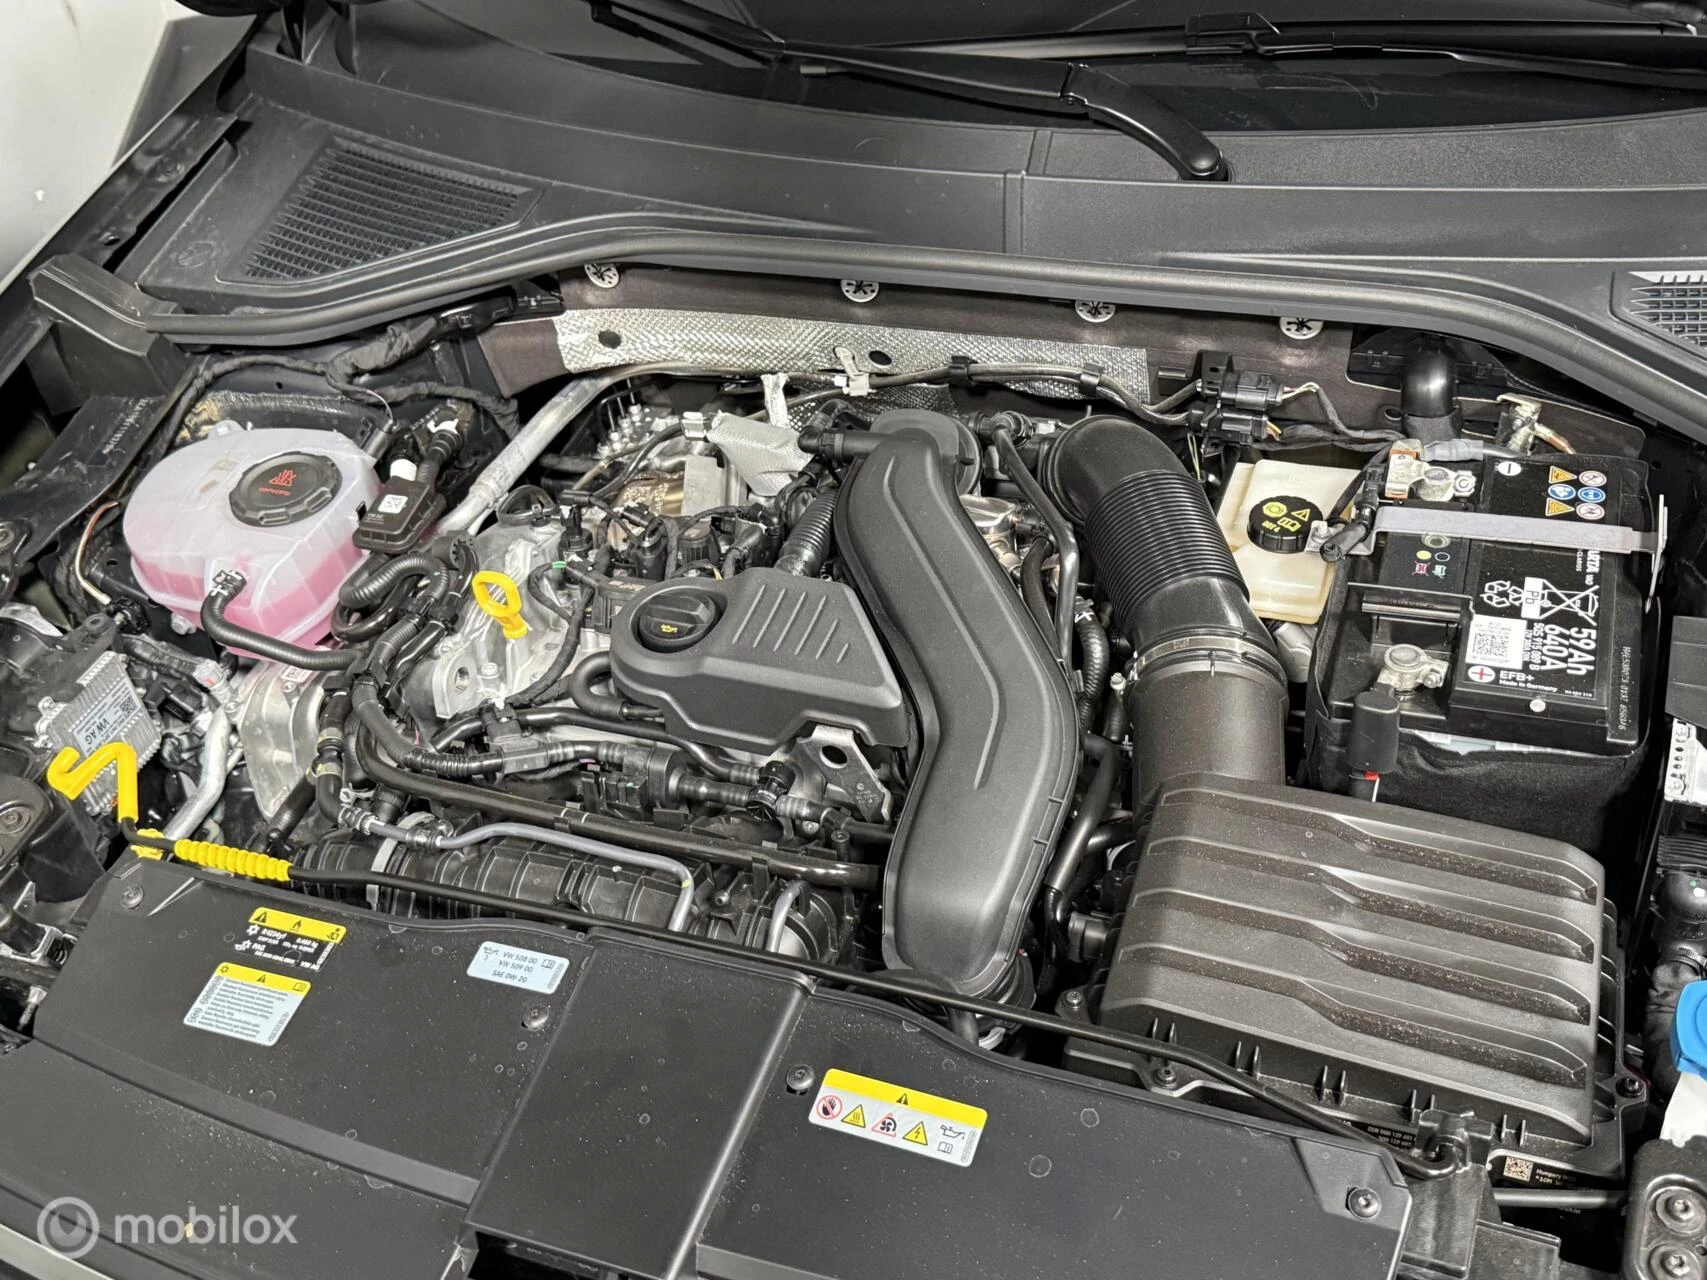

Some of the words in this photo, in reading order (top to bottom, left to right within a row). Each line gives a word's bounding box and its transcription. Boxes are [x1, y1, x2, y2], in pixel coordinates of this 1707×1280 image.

[1525, 590, 1540, 605] Pb
[1531, 637, 1543, 650] 915
[1540, 624, 1570, 670] 640A
[1567, 626, 1597, 676] 59Ah
[1499, 670, 1535, 682] EFB+
[1499, 679, 1518, 687] Made
[1526, 682, 1558, 693] Germany
[96, 718, 110, 732] VW
[84, 729, 97, 745] AG
[503, 951, 515, 960] VW
[515, 954, 528, 962] 508
[528, 957, 538, 965] 00
[499, 960, 509, 968] VW
[511, 962, 523, 970] 509
[524, 965, 534, 973] 00
[491, 970, 504, 978] SAE
[505, 973, 528, 983] 0W-20
